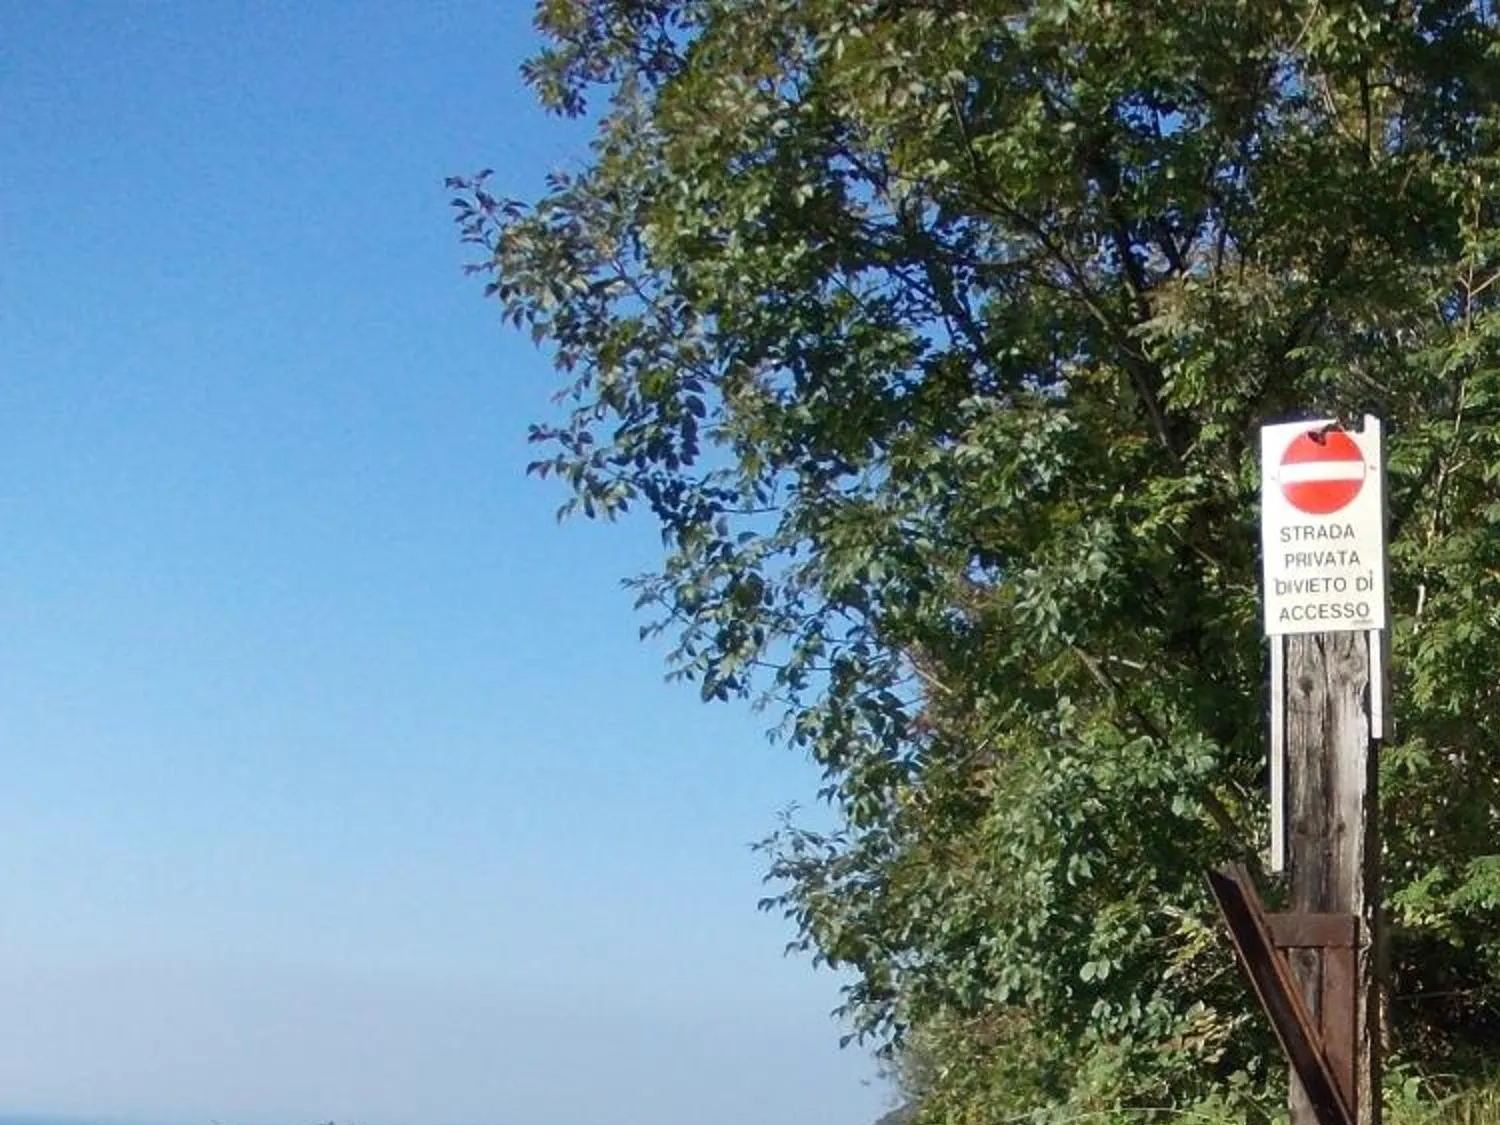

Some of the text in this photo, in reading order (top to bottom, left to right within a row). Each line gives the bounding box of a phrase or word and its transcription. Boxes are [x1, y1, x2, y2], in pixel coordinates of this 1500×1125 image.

[1280, 524, 1355, 543] STRADA
[1284, 550, 1361, 569] PRIVATA
[1275, 577, 1347, 596] DIVIETO
[1279, 602, 1370, 622] ACCESSO
